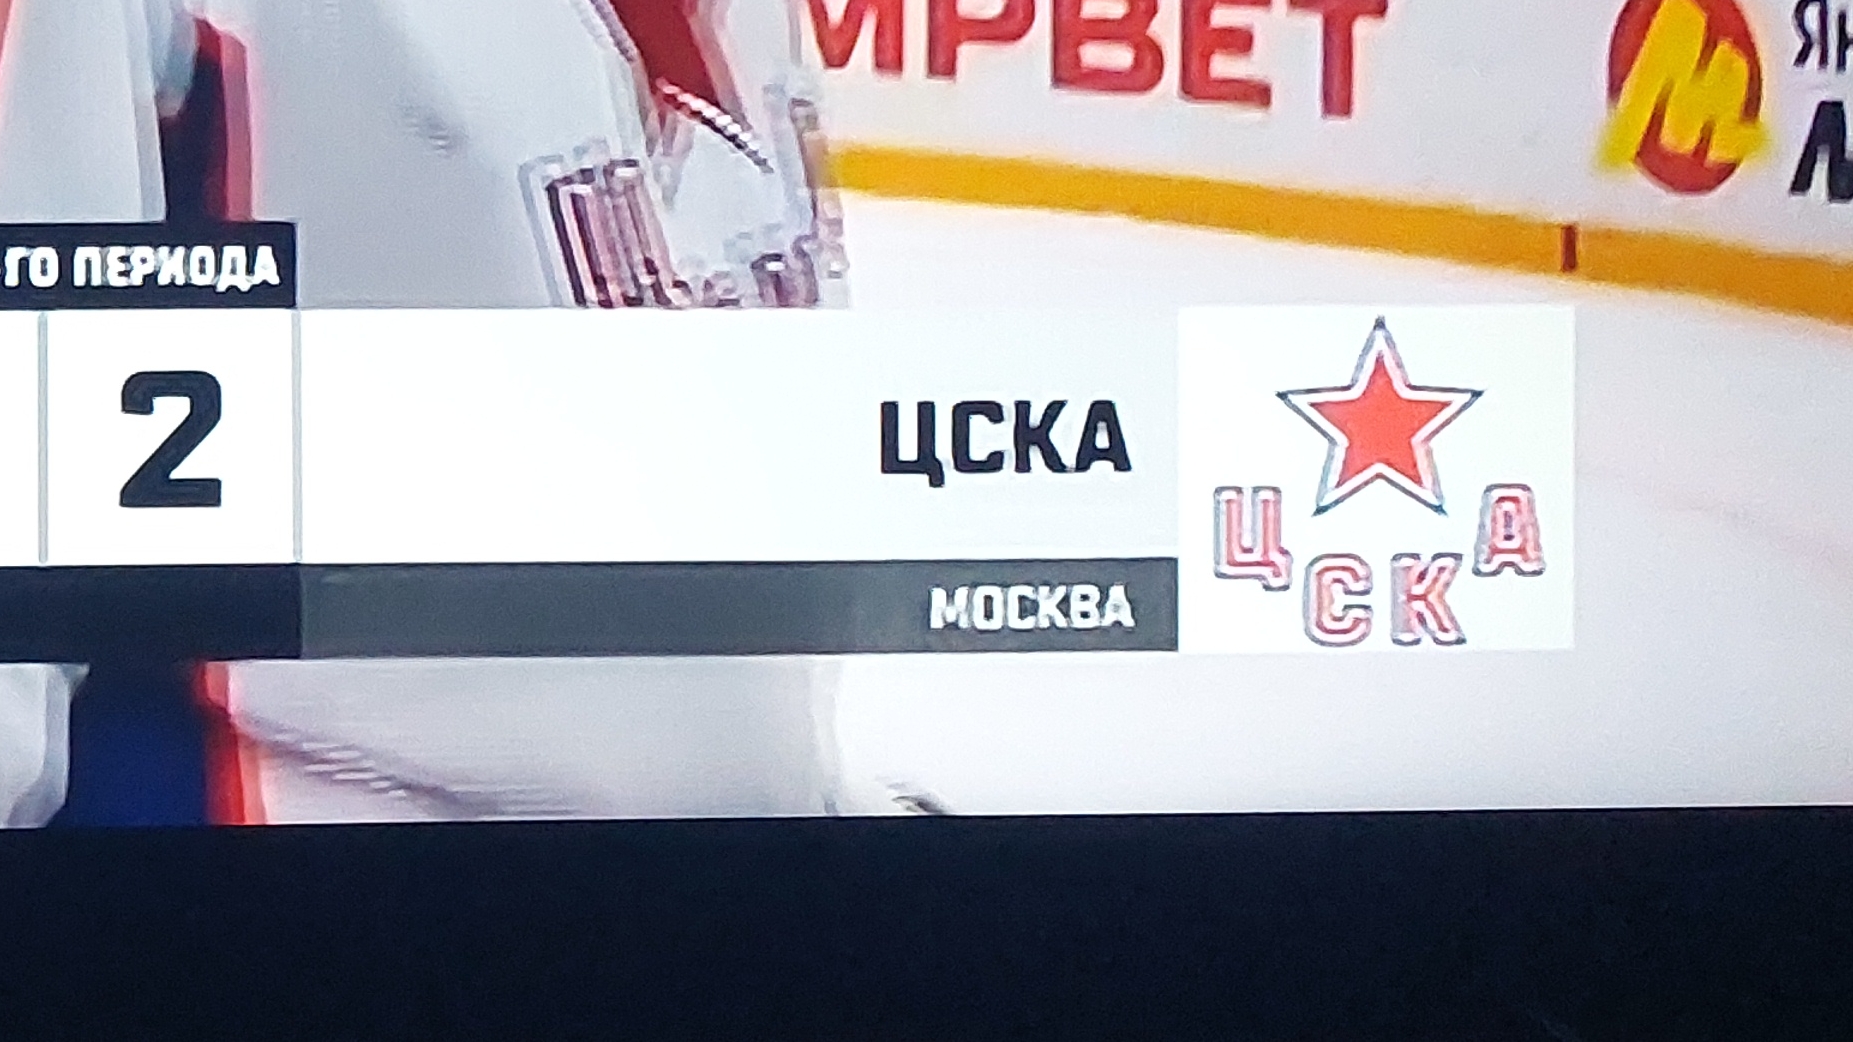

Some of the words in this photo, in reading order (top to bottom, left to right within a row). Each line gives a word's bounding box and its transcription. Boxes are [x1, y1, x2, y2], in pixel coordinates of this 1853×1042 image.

[73, 245, 281, 293] ПЕРИОДА
[118, 370, 222, 509] 2
[880, 399, 1133, 489] ЦСКА
[928, 583, 1137, 632] МОСКВА
[1212, 482, 1546, 648] ЦСКА
